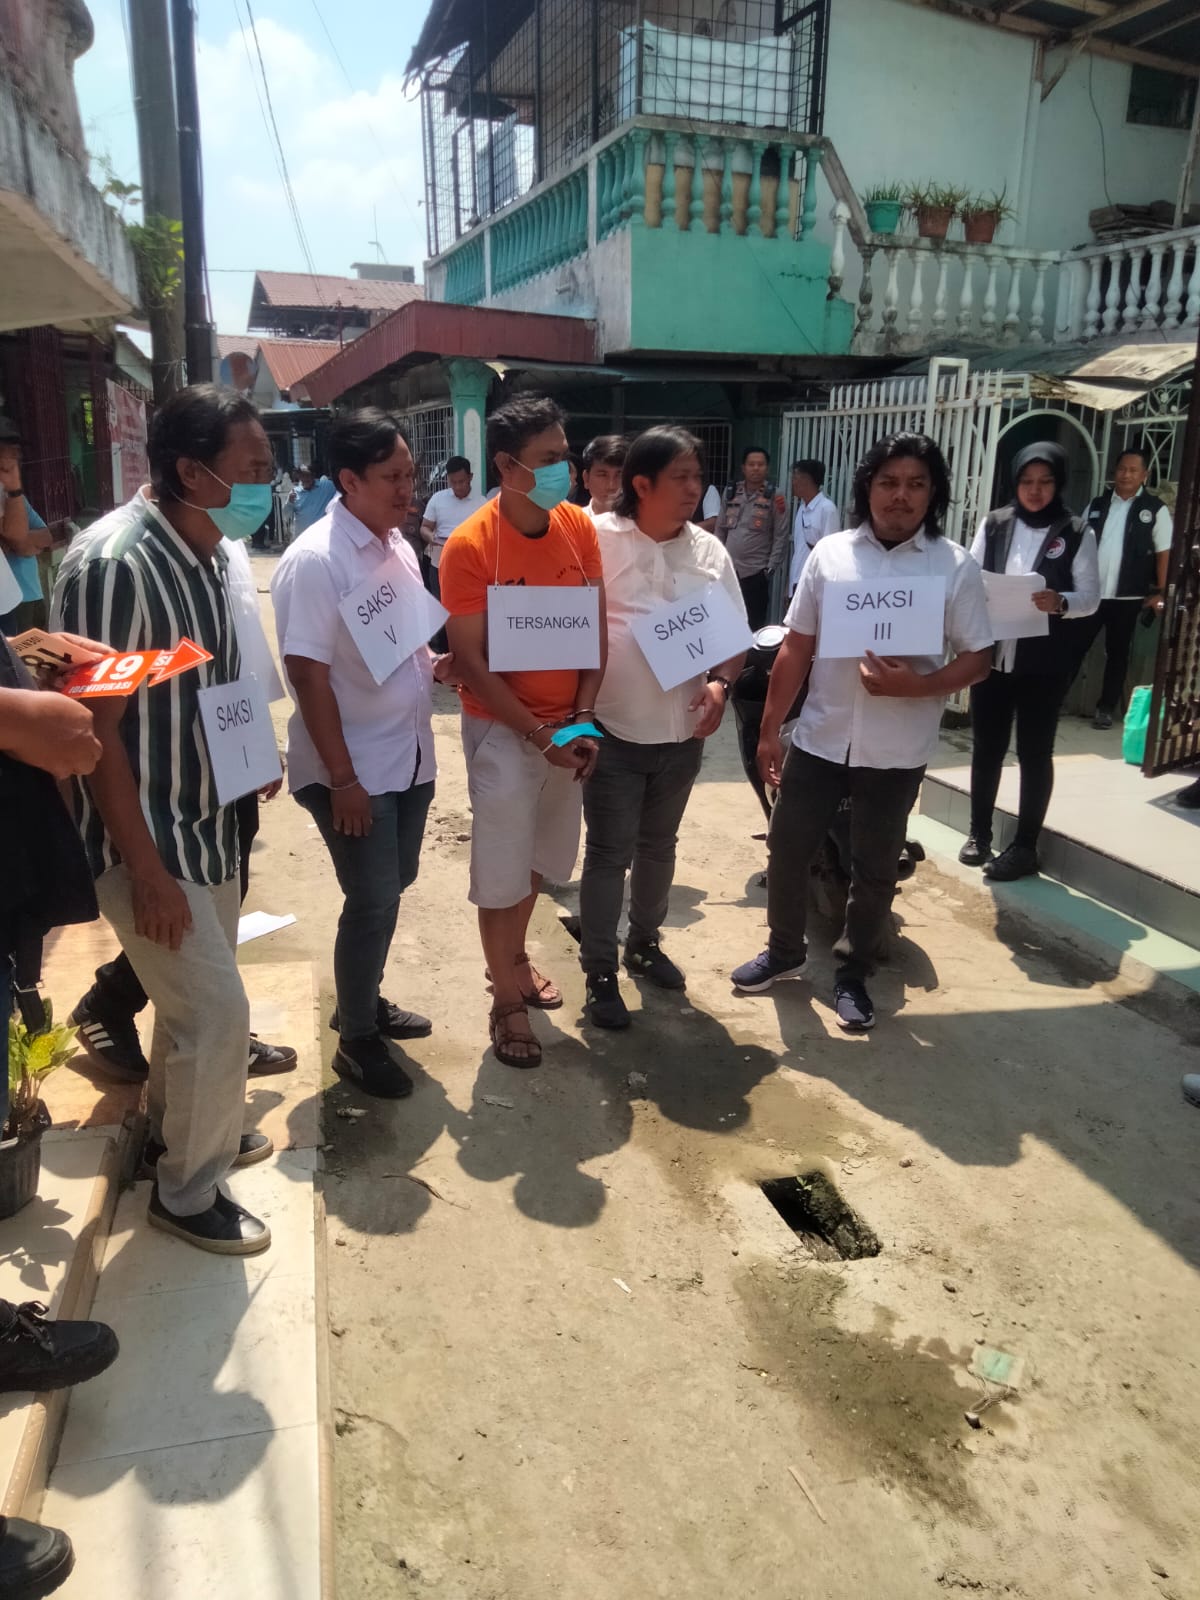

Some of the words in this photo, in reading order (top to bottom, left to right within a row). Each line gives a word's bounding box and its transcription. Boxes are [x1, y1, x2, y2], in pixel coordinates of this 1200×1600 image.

[357, 581, 397, 625] SAKSI
[846, 590, 913, 611] SAKSI
[506, 616, 590, 629] TERSANGKA
[654, 603, 710, 641] SAKSI
[384, 624, 397, 645] V
[686, 638, 704, 660] IV
[90, 655, 144, 682] 19
[68, 681, 133, 694] IDENTIFIKASI
[216, 698, 254, 732] SAKSI
